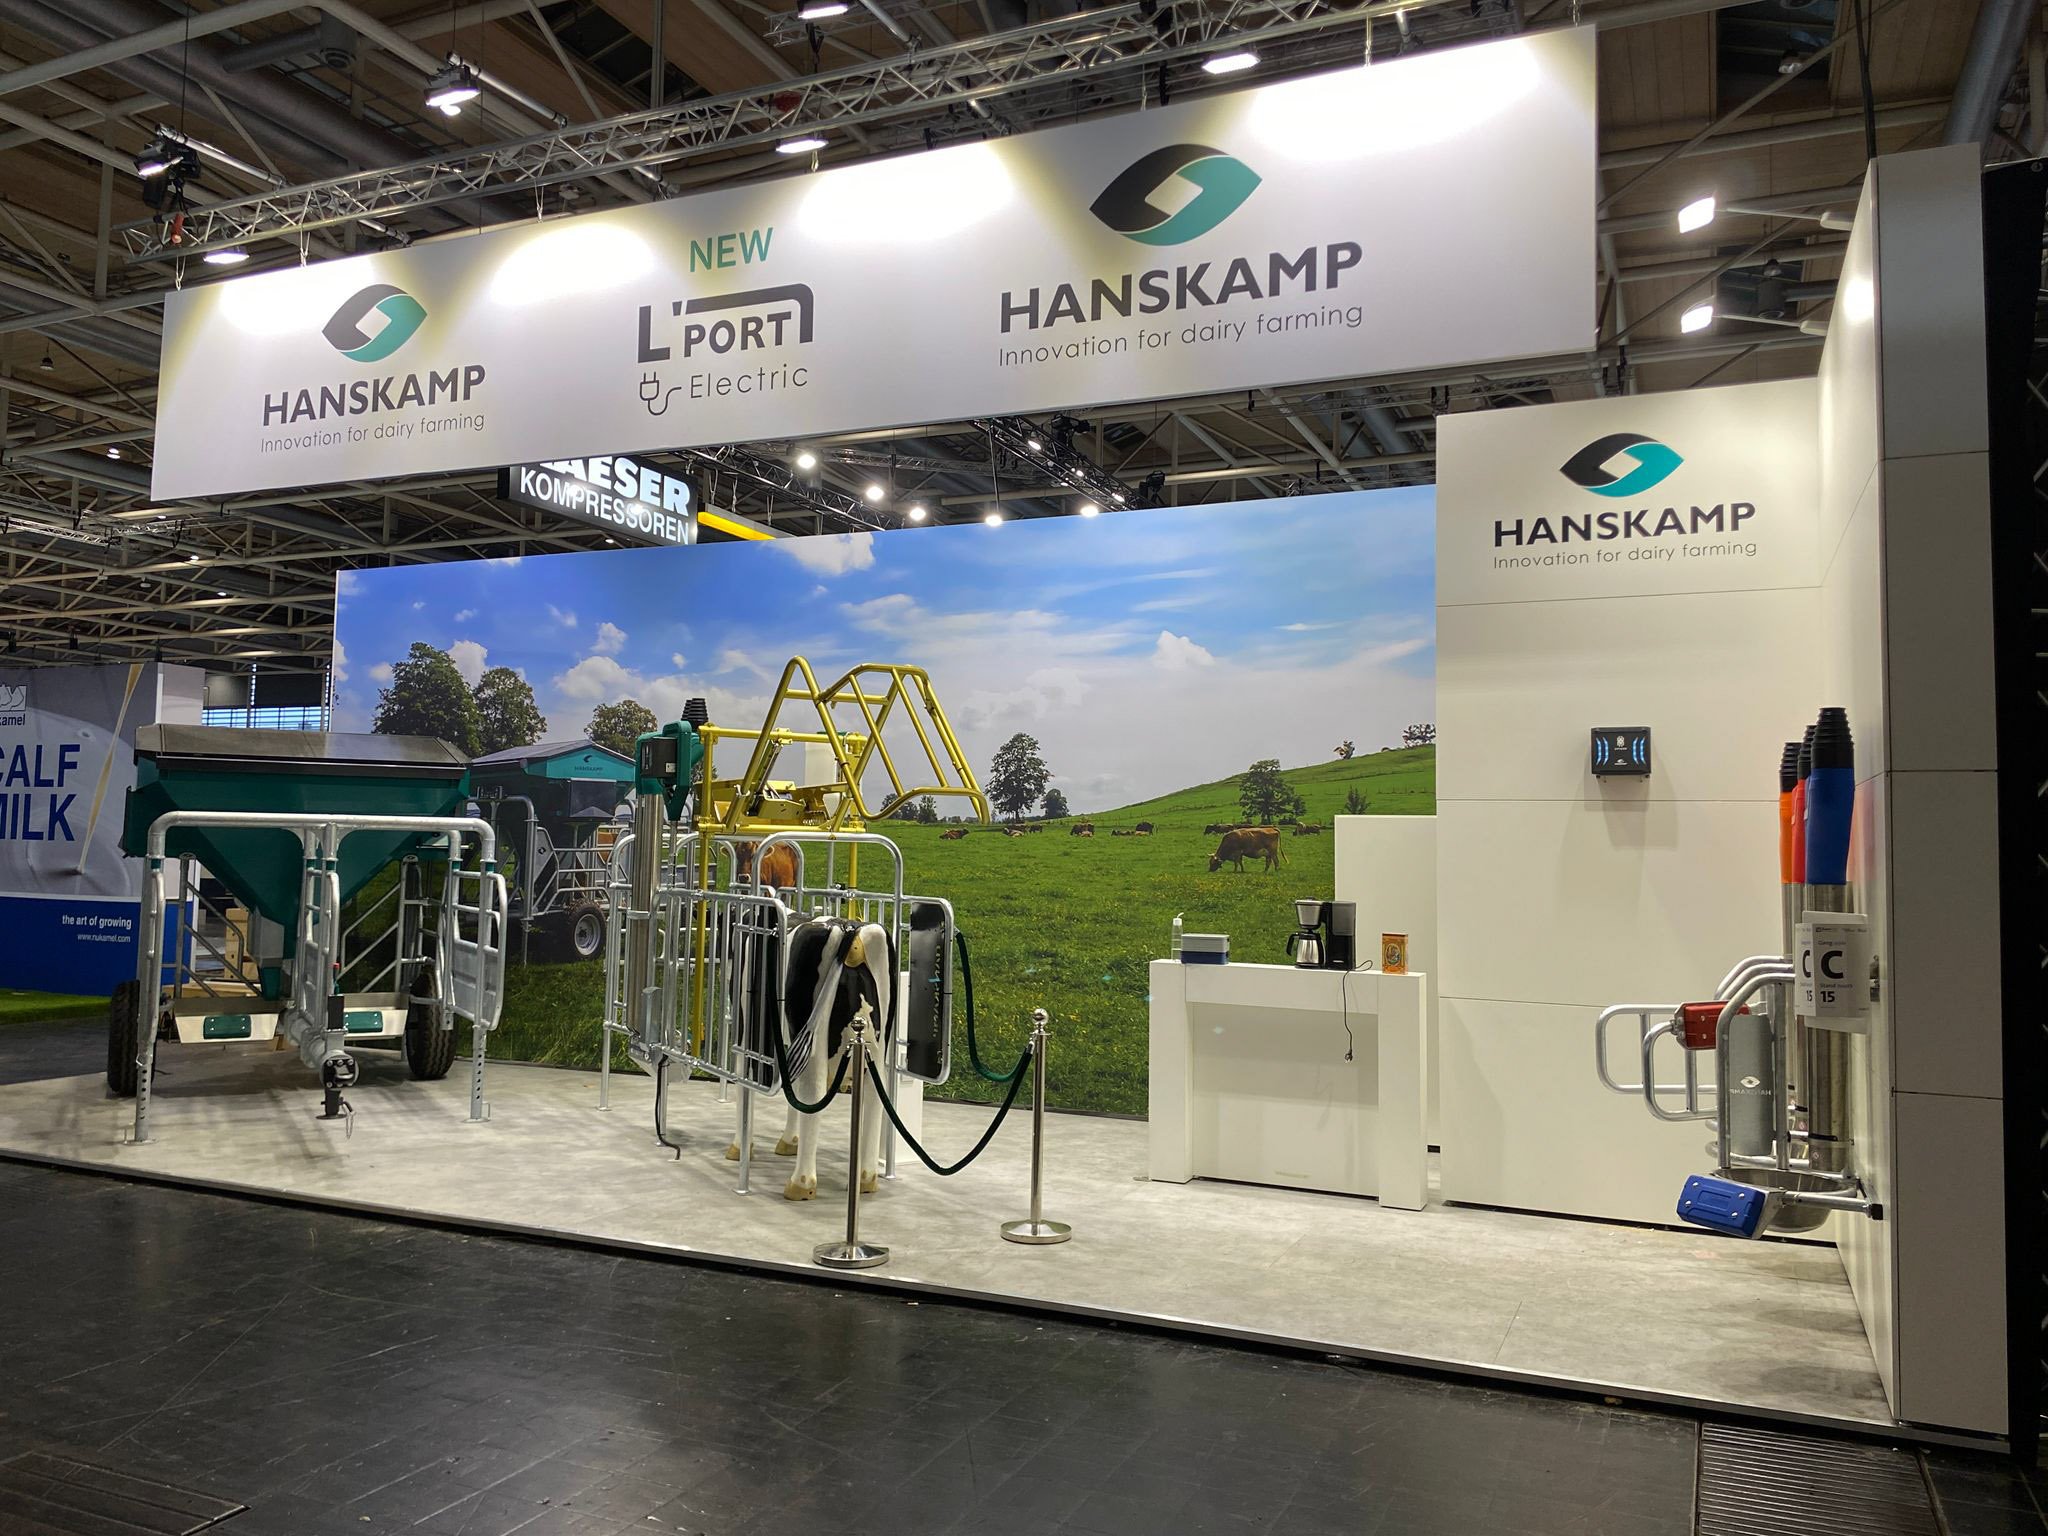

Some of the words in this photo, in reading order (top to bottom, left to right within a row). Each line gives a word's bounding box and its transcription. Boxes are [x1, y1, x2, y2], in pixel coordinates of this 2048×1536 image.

[690, 227, 774, 273] NEW
[1000, 241, 1363, 333] HANSKAMP
[999, 333, 1128, 367] Innovation
[1137, 327, 1171, 350] for
[1181, 318, 1246, 344] dairy
[1257, 304, 1363, 335] farming
[263, 365, 486, 426] HANSKAMP
[690, 363, 808, 399] Electric
[260, 430, 342, 453] Innovation
[347, 426, 368, 443] for
[374, 420, 414, 440] dairy
[420, 412, 486, 434] farming
[520, 466, 689, 545] KOMPRESSOREN
[538, 455, 691, 517] AESER
[1494, 502, 1756, 548] HANSKAMP
[1494, 551, 1590, 569] Innovation
[1597, 549, 1621, 563] for
[1628, 544, 1675, 561] dairy
[1683, 541, 1757, 557] farming
[0, 743, 81, 788] ALF
[62, 914, 75, 925] the
[76, 915, 88, 926] art
[89, 915, 98, 926] of
[99, 916, 132, 930] growing
[1820, 950, 1844, 979] C
[1820, 991, 1835, 1002] 15
